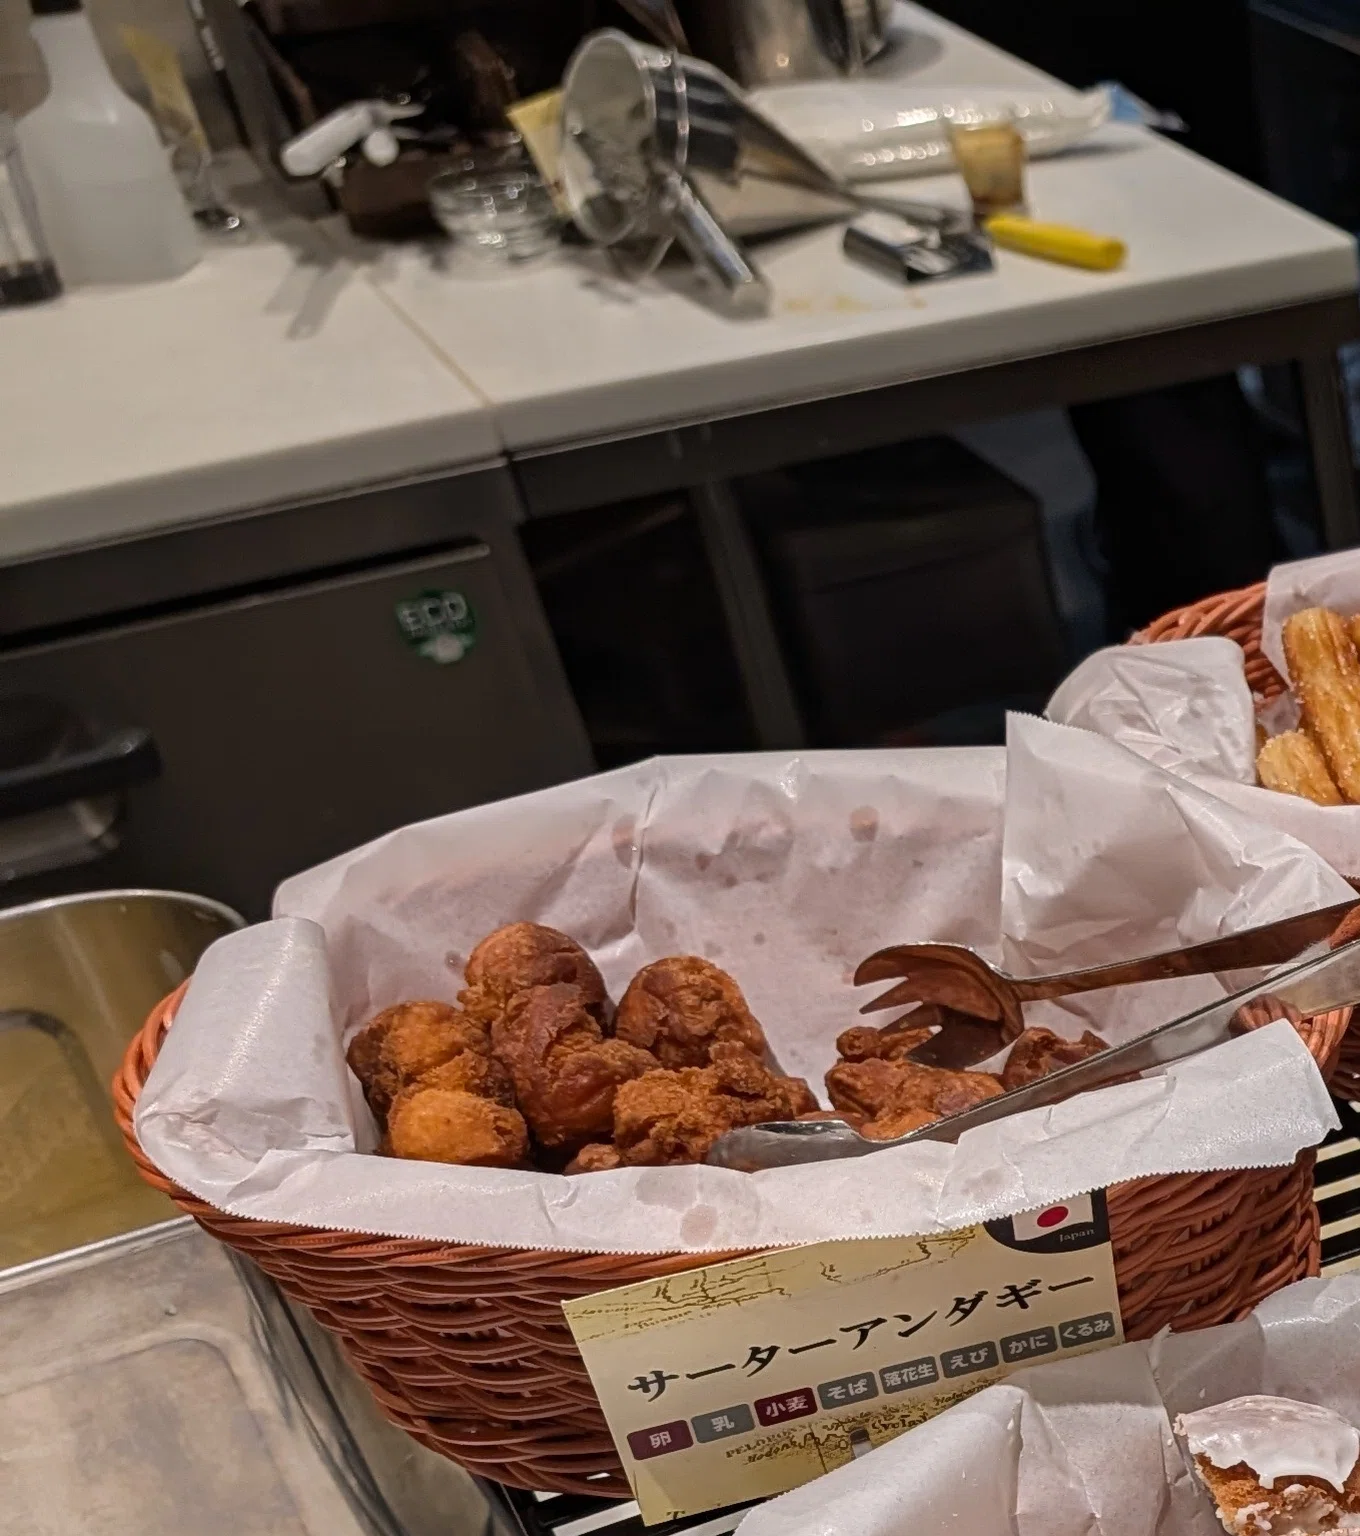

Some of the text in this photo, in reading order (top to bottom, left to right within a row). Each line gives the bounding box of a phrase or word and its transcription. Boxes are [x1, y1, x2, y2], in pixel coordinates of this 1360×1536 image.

[1059, 1228, 1095, 1243] Japan
[627, 1276, 1094, 1402] サーターアンダギー
[649, 1319, 1111, 1449] 卵 乳 小麦 そば 落花生 えび かに くるみ
